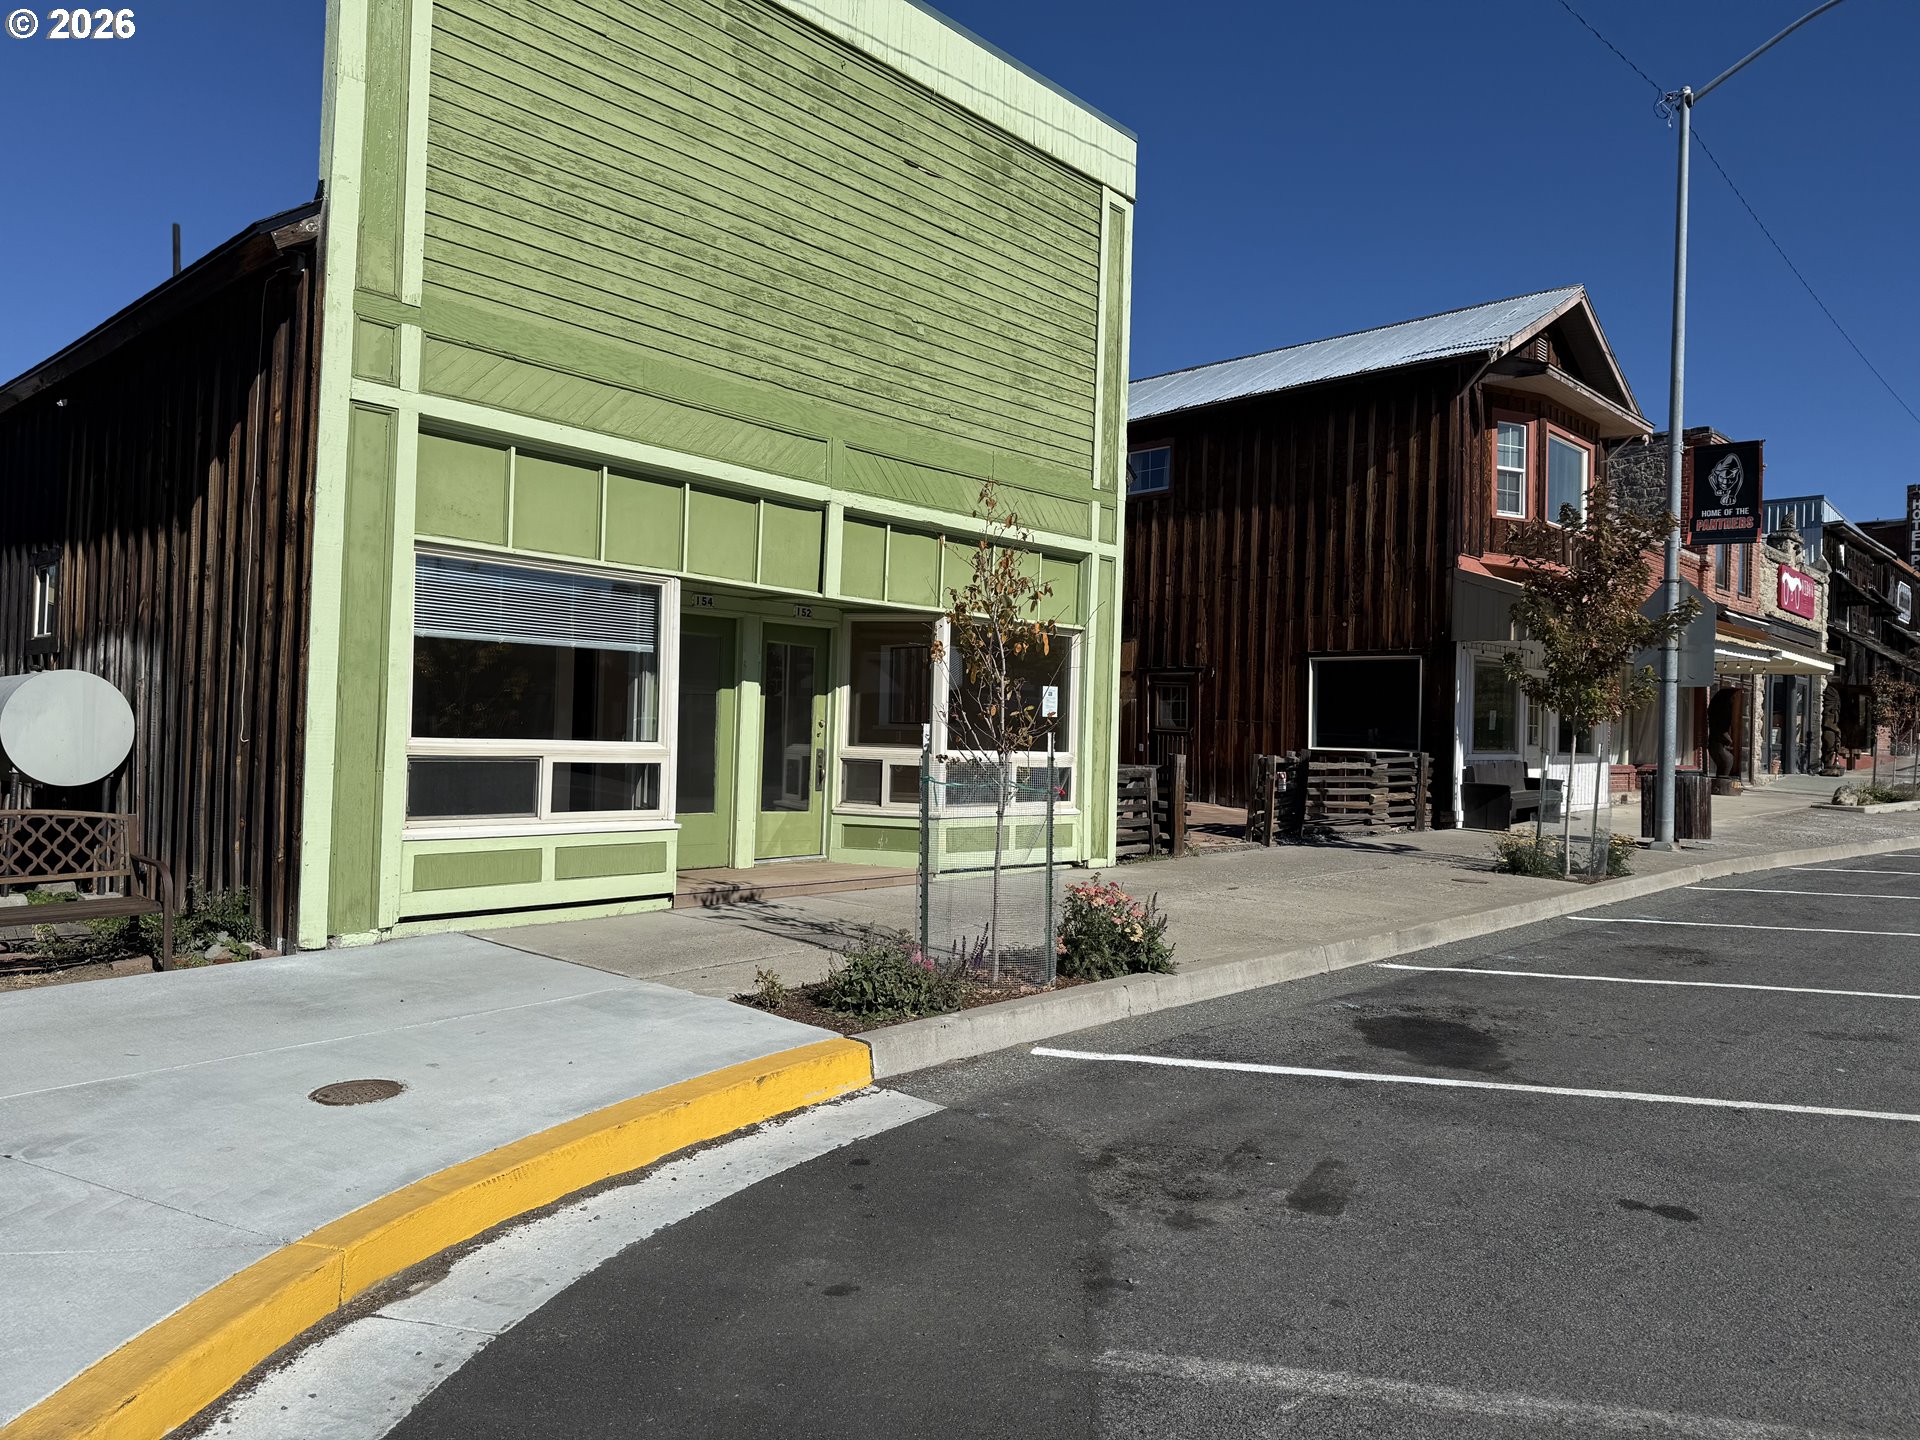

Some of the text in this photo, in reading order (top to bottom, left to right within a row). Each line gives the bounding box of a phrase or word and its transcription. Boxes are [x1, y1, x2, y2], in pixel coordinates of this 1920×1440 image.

[1701, 507, 1750, 518] HOME OF THE
[1695, 516, 1754, 531] PANTHERS
[1911, 498, 1920, 552] HOTEL
[696, 595, 713, 607] 154
[797, 607, 812, 618] 152
